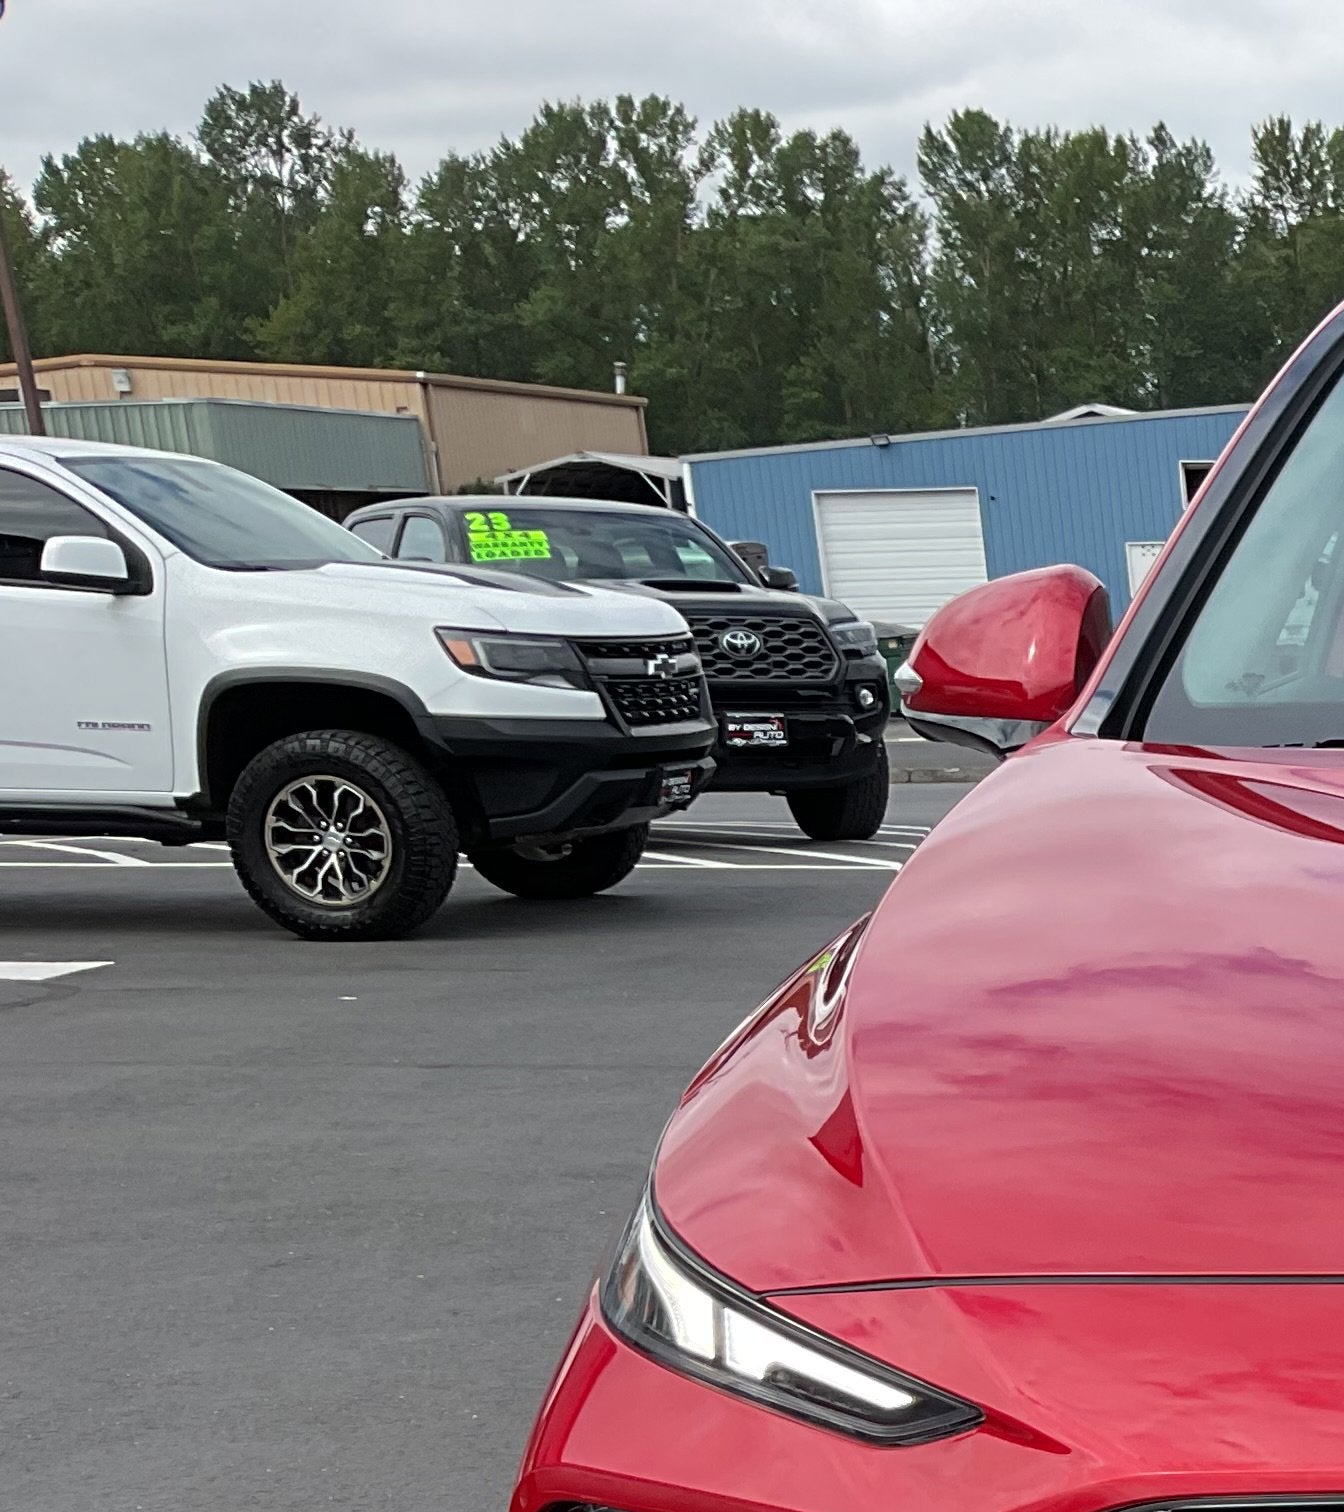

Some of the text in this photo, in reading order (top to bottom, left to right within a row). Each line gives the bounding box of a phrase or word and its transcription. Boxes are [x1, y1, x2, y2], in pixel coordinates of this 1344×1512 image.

[464, 512, 511, 531] 23
[472, 541, 545, 549] WARRANTY
[475, 549, 546, 559] LOADED
[728, 723, 741, 731] BY
[754, 731, 784, 739] AUTO
